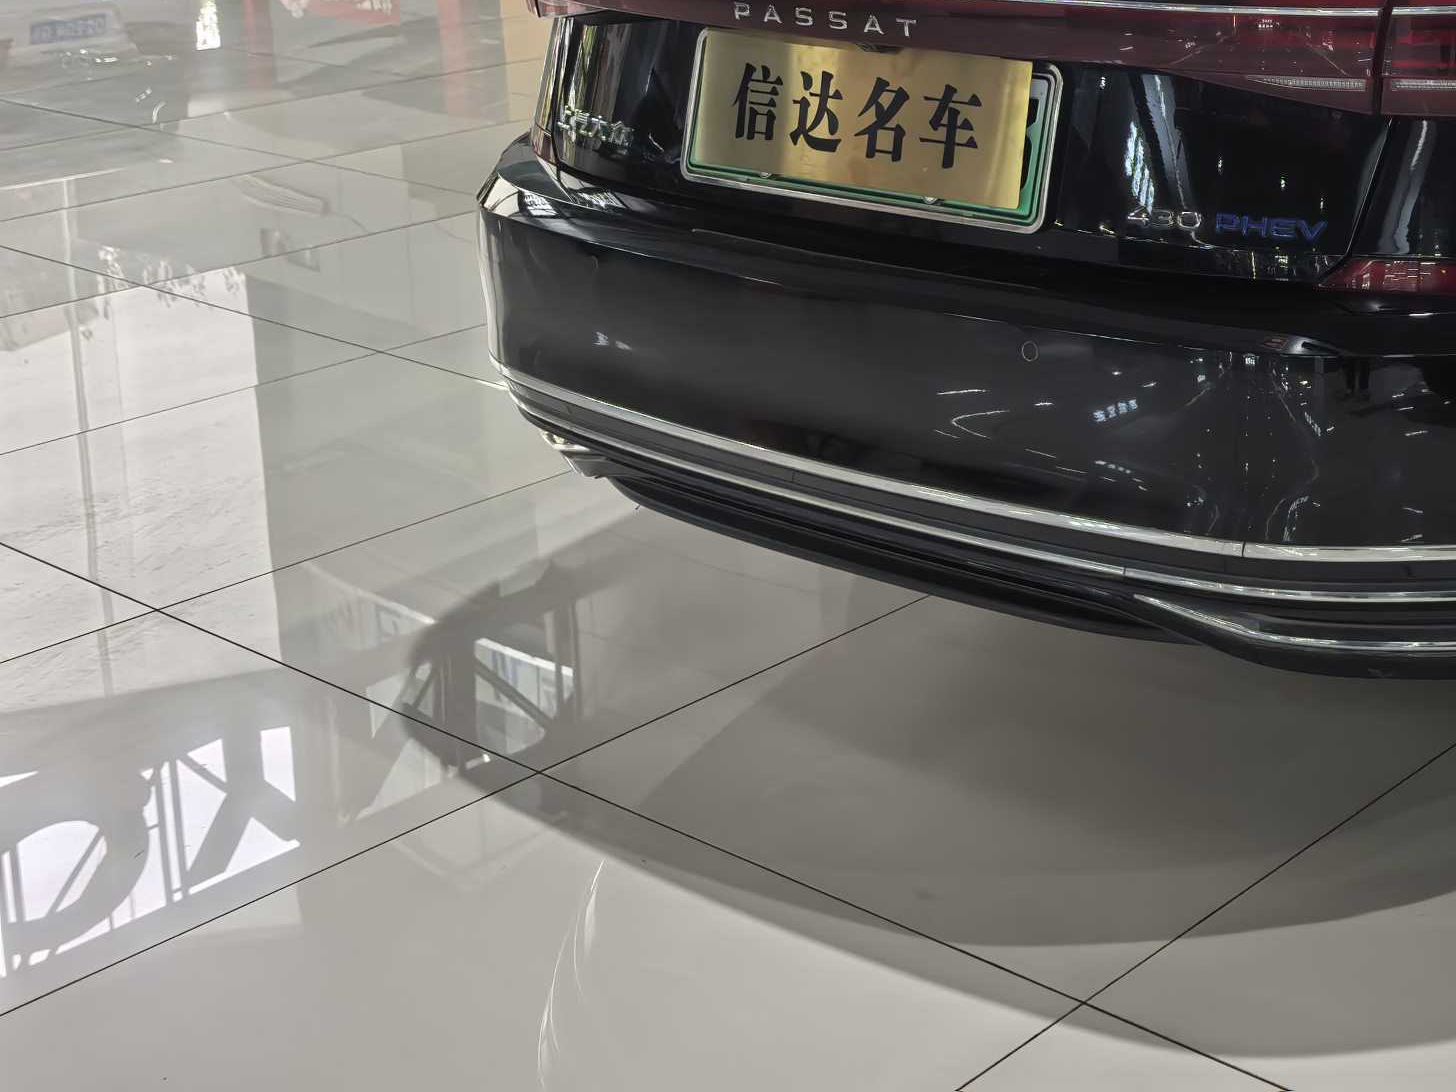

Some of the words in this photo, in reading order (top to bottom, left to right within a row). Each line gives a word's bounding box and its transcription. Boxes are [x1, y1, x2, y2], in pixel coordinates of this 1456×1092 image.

[733, 0, 918, 38] PASSAT
[731, 60, 984, 170] 信达名车
[1127, 207, 1202, 229] 430
[1215, 211, 1328, 241] PHEV
